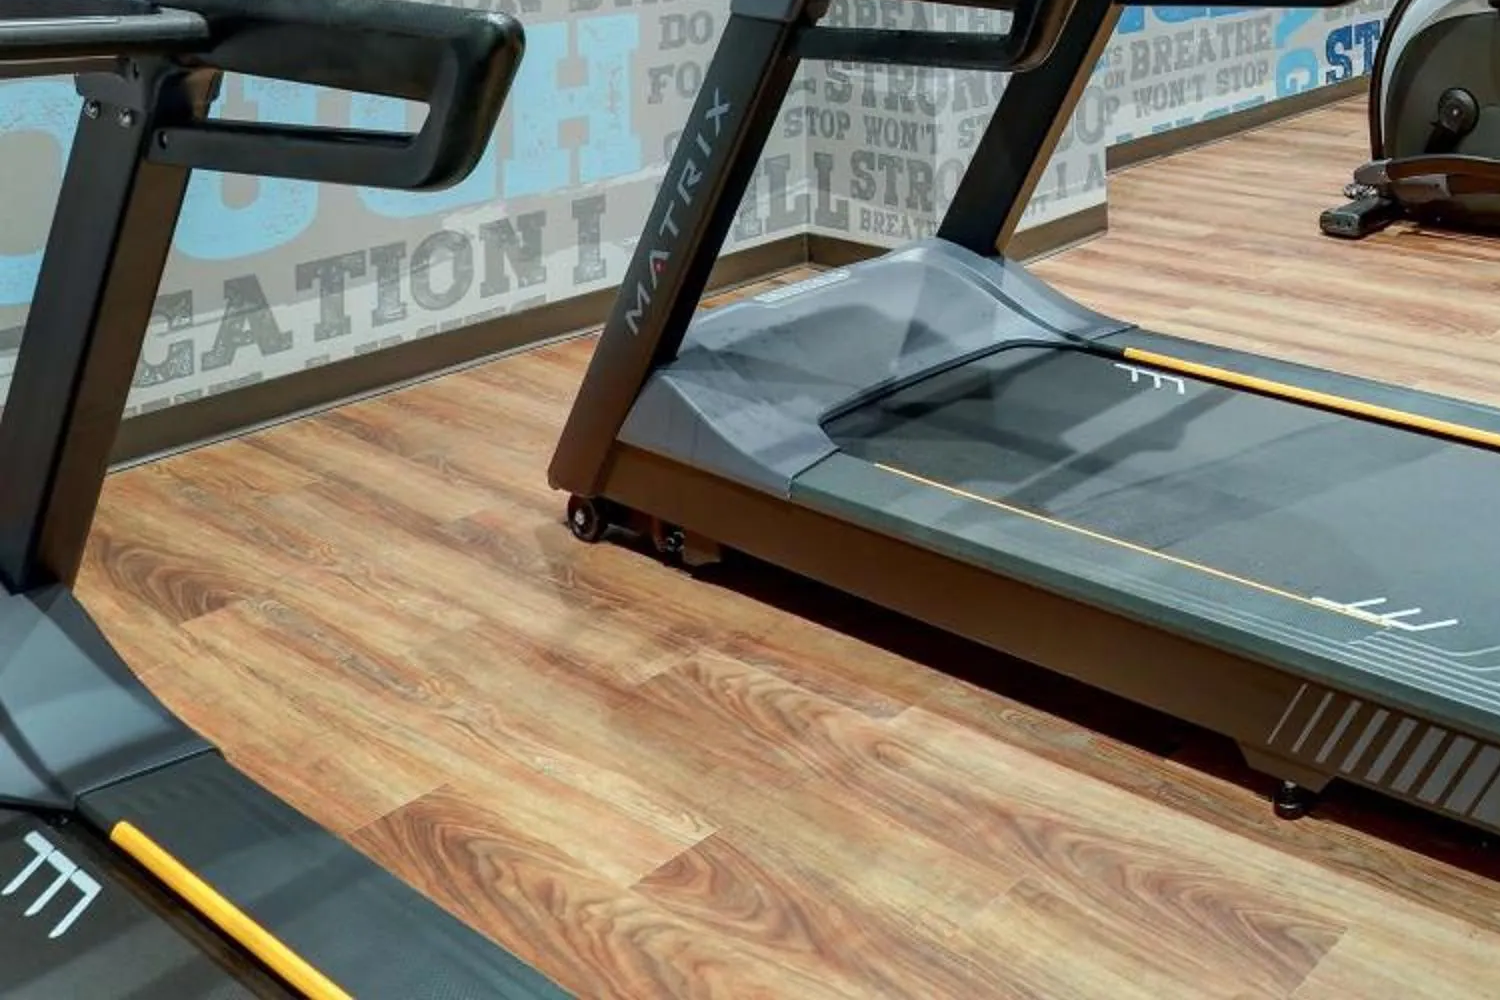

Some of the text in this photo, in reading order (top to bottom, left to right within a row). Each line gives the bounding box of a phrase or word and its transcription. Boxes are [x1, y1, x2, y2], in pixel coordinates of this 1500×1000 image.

[658, 10, 714, 51] DO
[1129, 12, 1272, 82] BREATHE
[1131, 75, 1205, 120] WON'T
[1214, 59, 1269, 97] STOP
[623, 87, 732, 336] MATRIX
